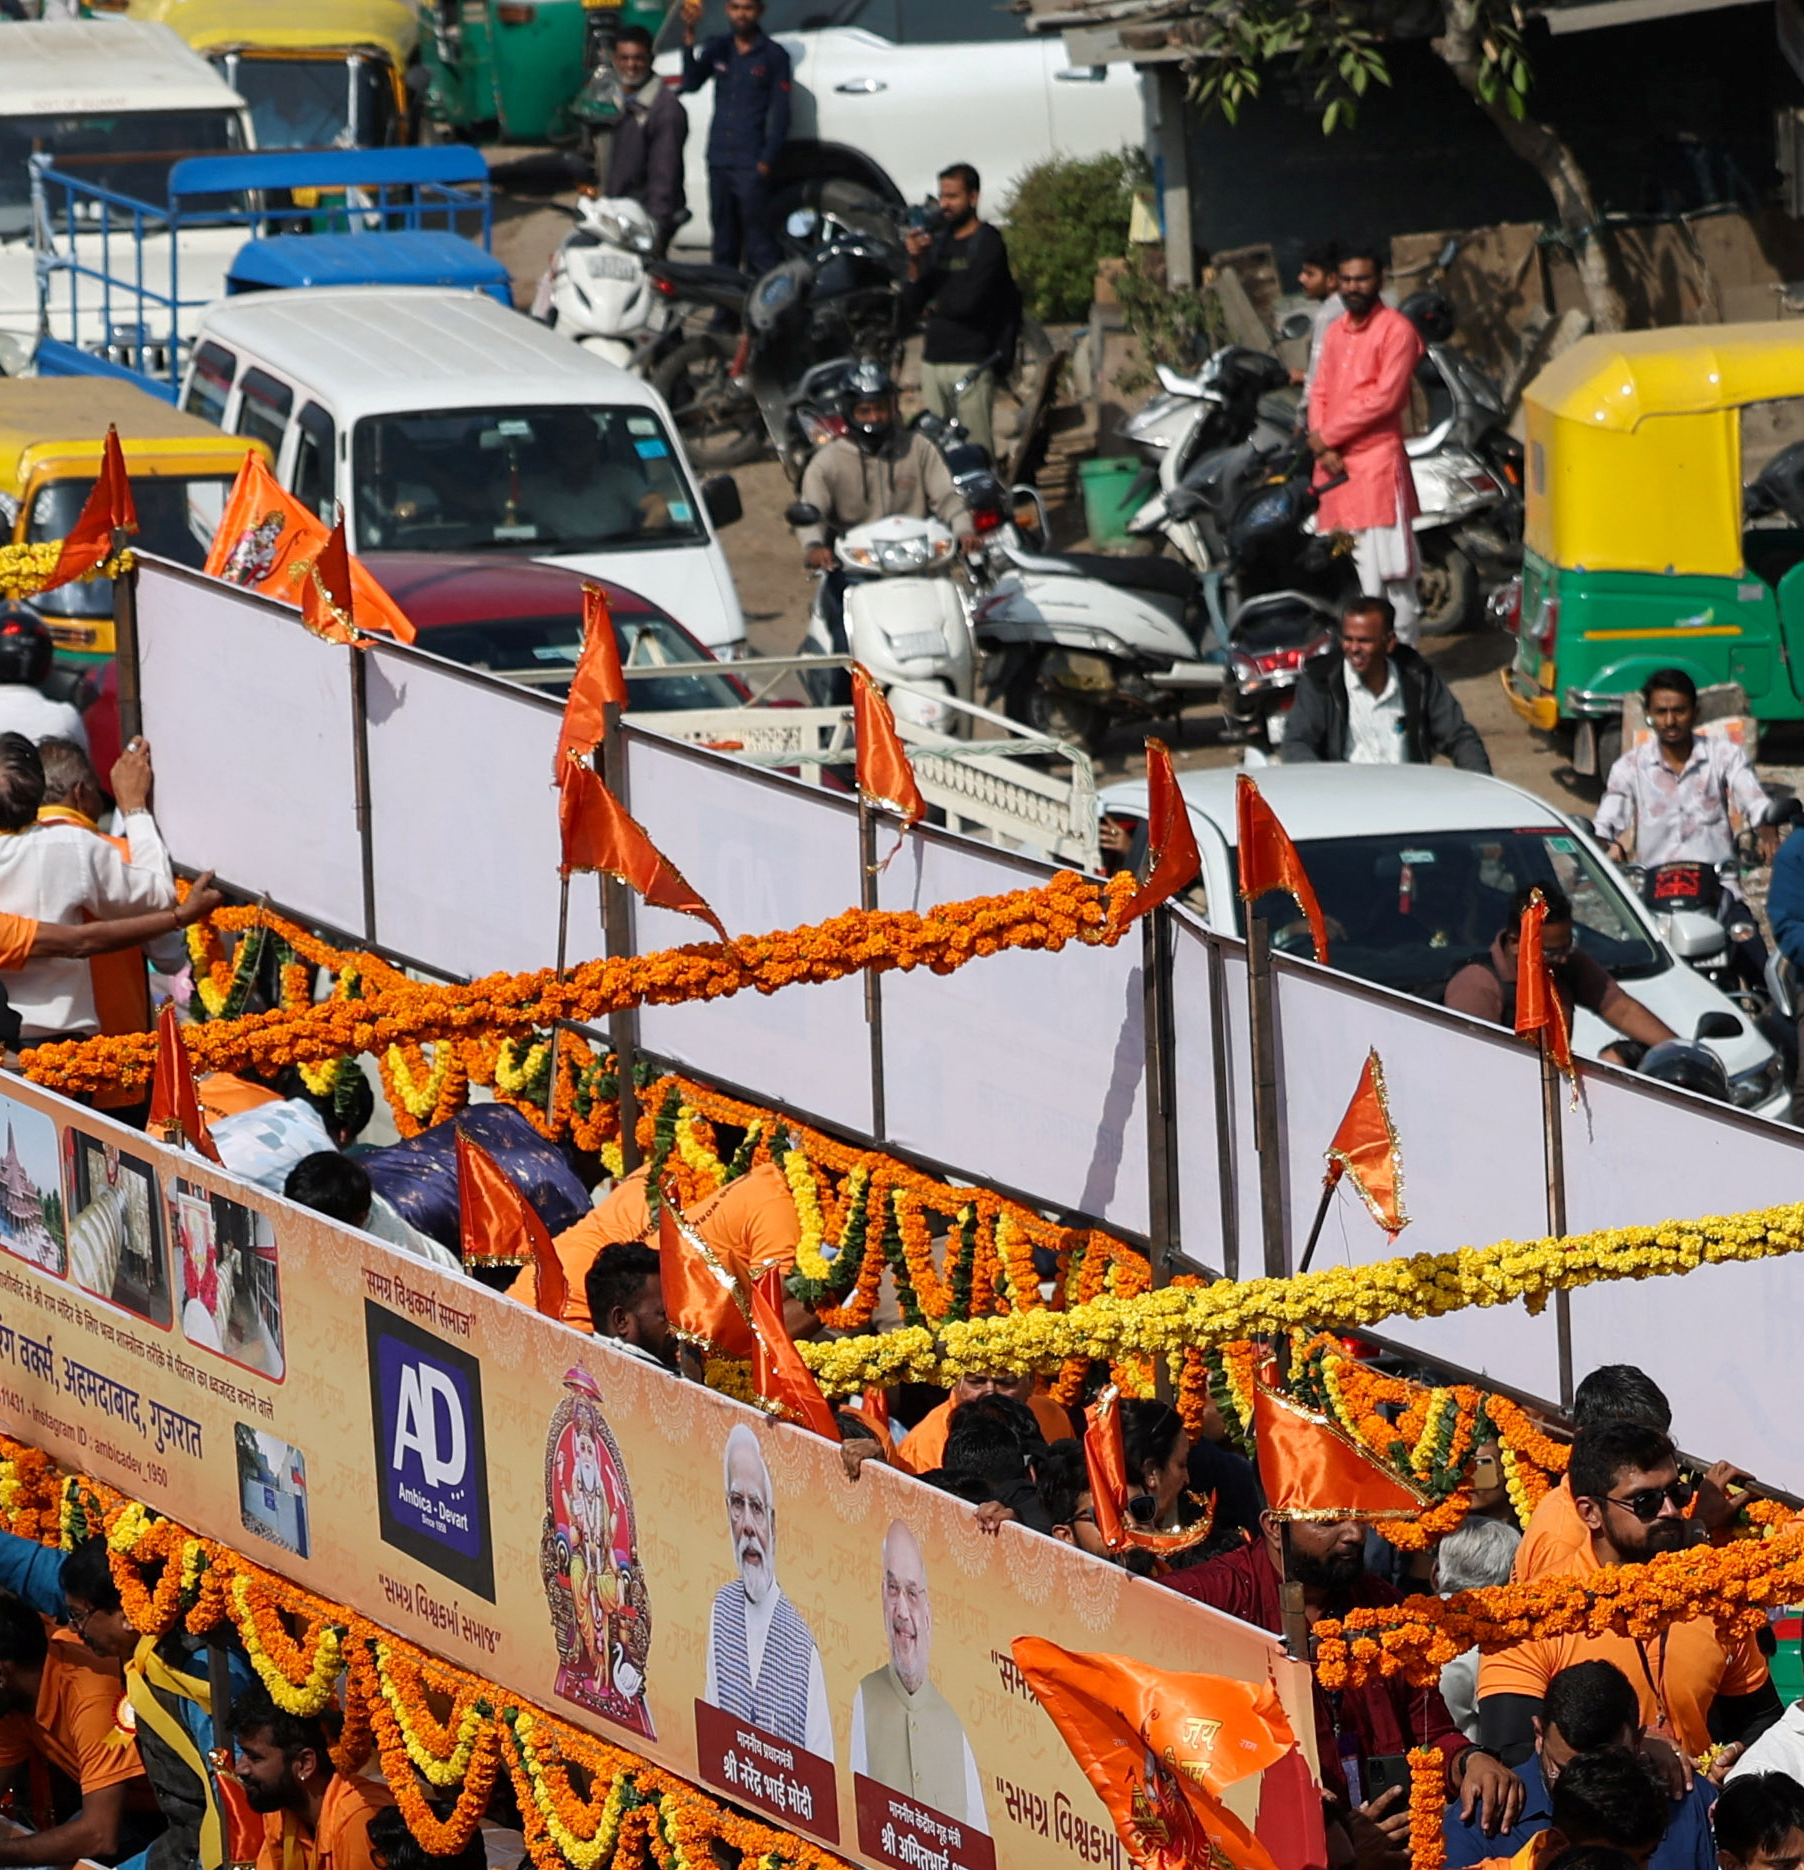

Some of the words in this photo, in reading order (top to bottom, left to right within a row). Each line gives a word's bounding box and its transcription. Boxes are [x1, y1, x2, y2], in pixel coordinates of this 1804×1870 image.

[62, 1356, 147, 1439] अहमदाबाद,
[149, 1399, 203, 1459] गुजरात
[393, 1361, 467, 1488] AD
[32, 1402, 76, 1443] Instagram
[77, 1426, 87, 1447] ID
[95, 1439, 168, 1488] ambicadev_1950
[398, 1482, 432, 1514] Ambica
[438, 1501, 469, 1532] Devart
[421, 1513, 435, 1528] Since
[736, 1729, 762, 1763] माननीय
[1183, 1717, 1223, 1751] जय
[723, 1749, 738, 1784] श्री
[739, 1757, 762, 1798] नरेंद्र
[763, 1773, 786, 1811] भाई
[787, 1779, 813, 1821] मोदी
[881, 1822, 896, 1857] श्री
[888, 1800, 914, 1825] माननीय
[936, 1820, 947, 1847] गृह
[948, 1825, 962, 1849] मंत्री
